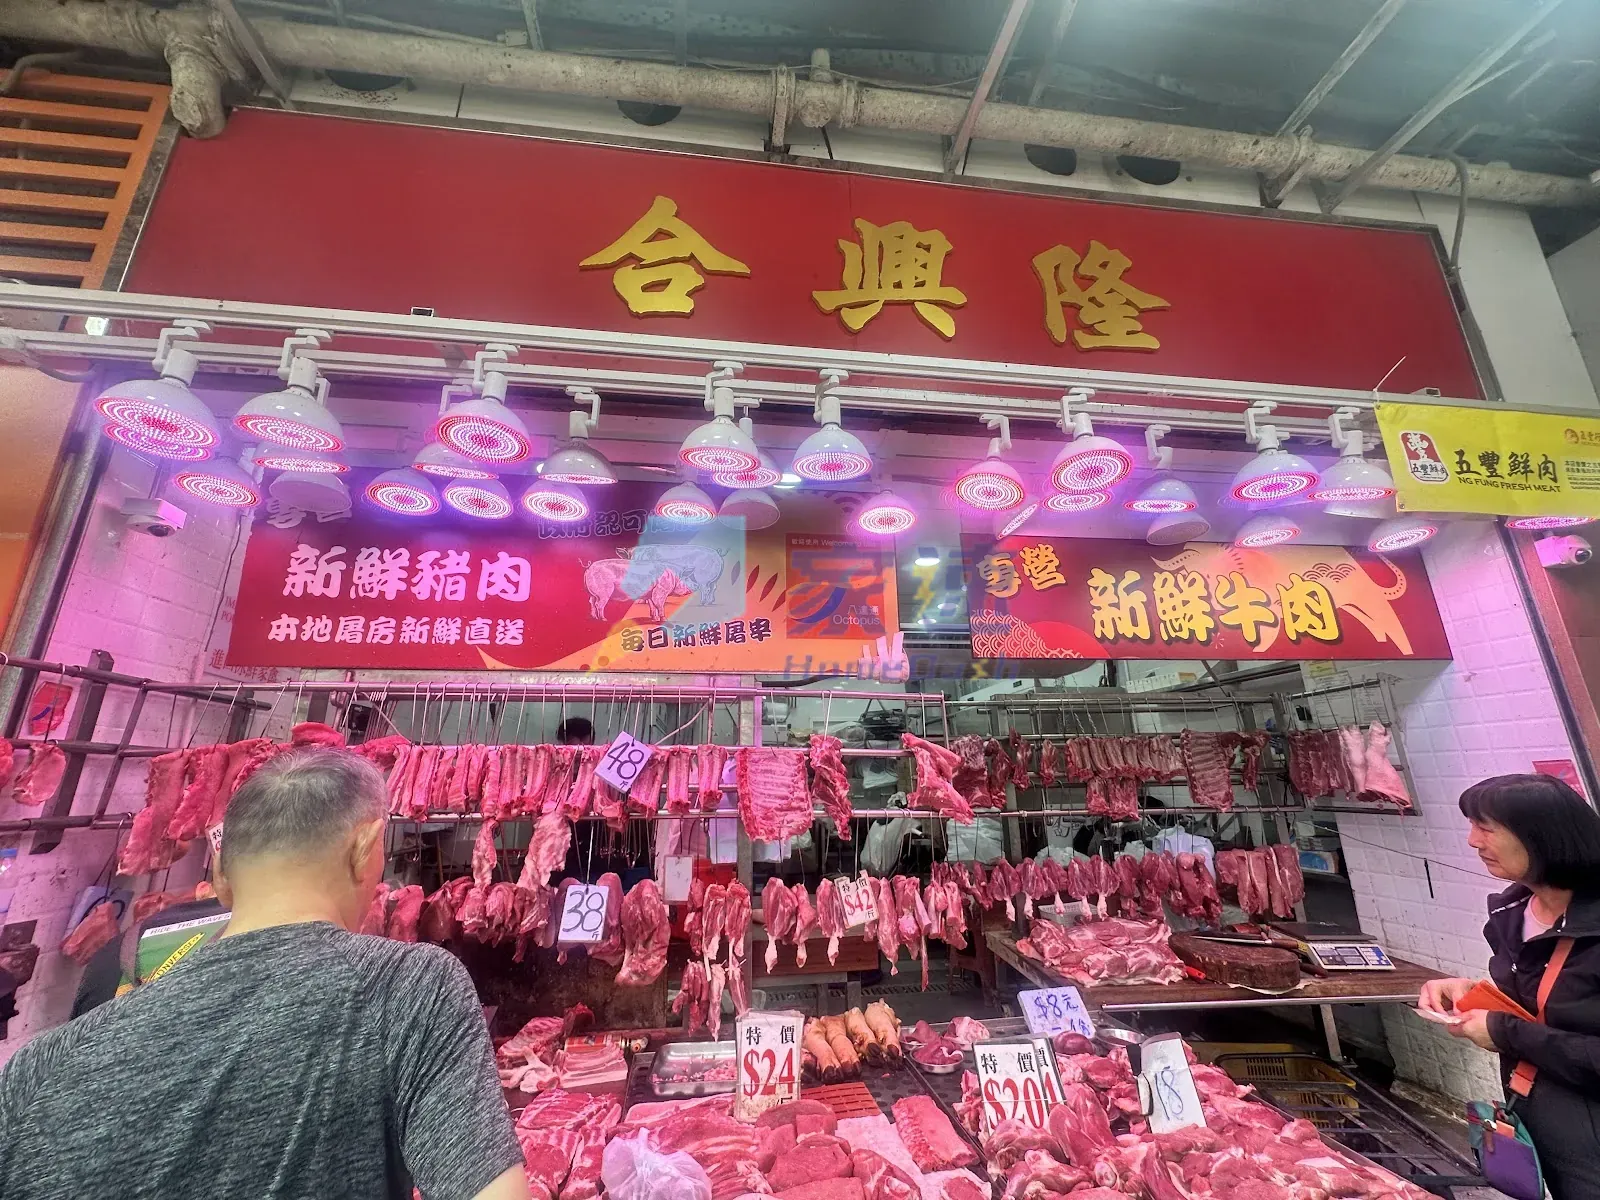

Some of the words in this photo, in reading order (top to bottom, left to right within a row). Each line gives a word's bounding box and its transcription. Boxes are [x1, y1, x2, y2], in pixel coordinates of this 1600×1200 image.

[580, 195, 1171, 351] 合興隆
[1454, 448, 1558, 484] 五豐鮮肉
[1457, 477, 1474, 485] NG
[1475, 478, 1500, 488] FUNG
[1500, 481, 1532, 491] FRESH
[1533, 484, 1561, 493] MEAT
[282, 544, 532, 602] 新鮮豬肉
[976, 543, 1067, 599] 專營
[832, 614, 880, 627] Octopus
[1086, 567, 1343, 643] 新鮮牛肉
[267, 613, 525, 646] 本地屠房新鮮直送
[620, 617, 772, 653] 每日新鮮屠宰
[607, 741, 645, 779] 48
[562, 890, 605, 932] 38
[844, 889, 873, 916] $42
[745, 1024, 795, 1046] 特價
[743, 1047, 796, 1100] $24
[981, 1051, 1035, 1074] 特價
[1154, 1066, 1184, 1121] 18
